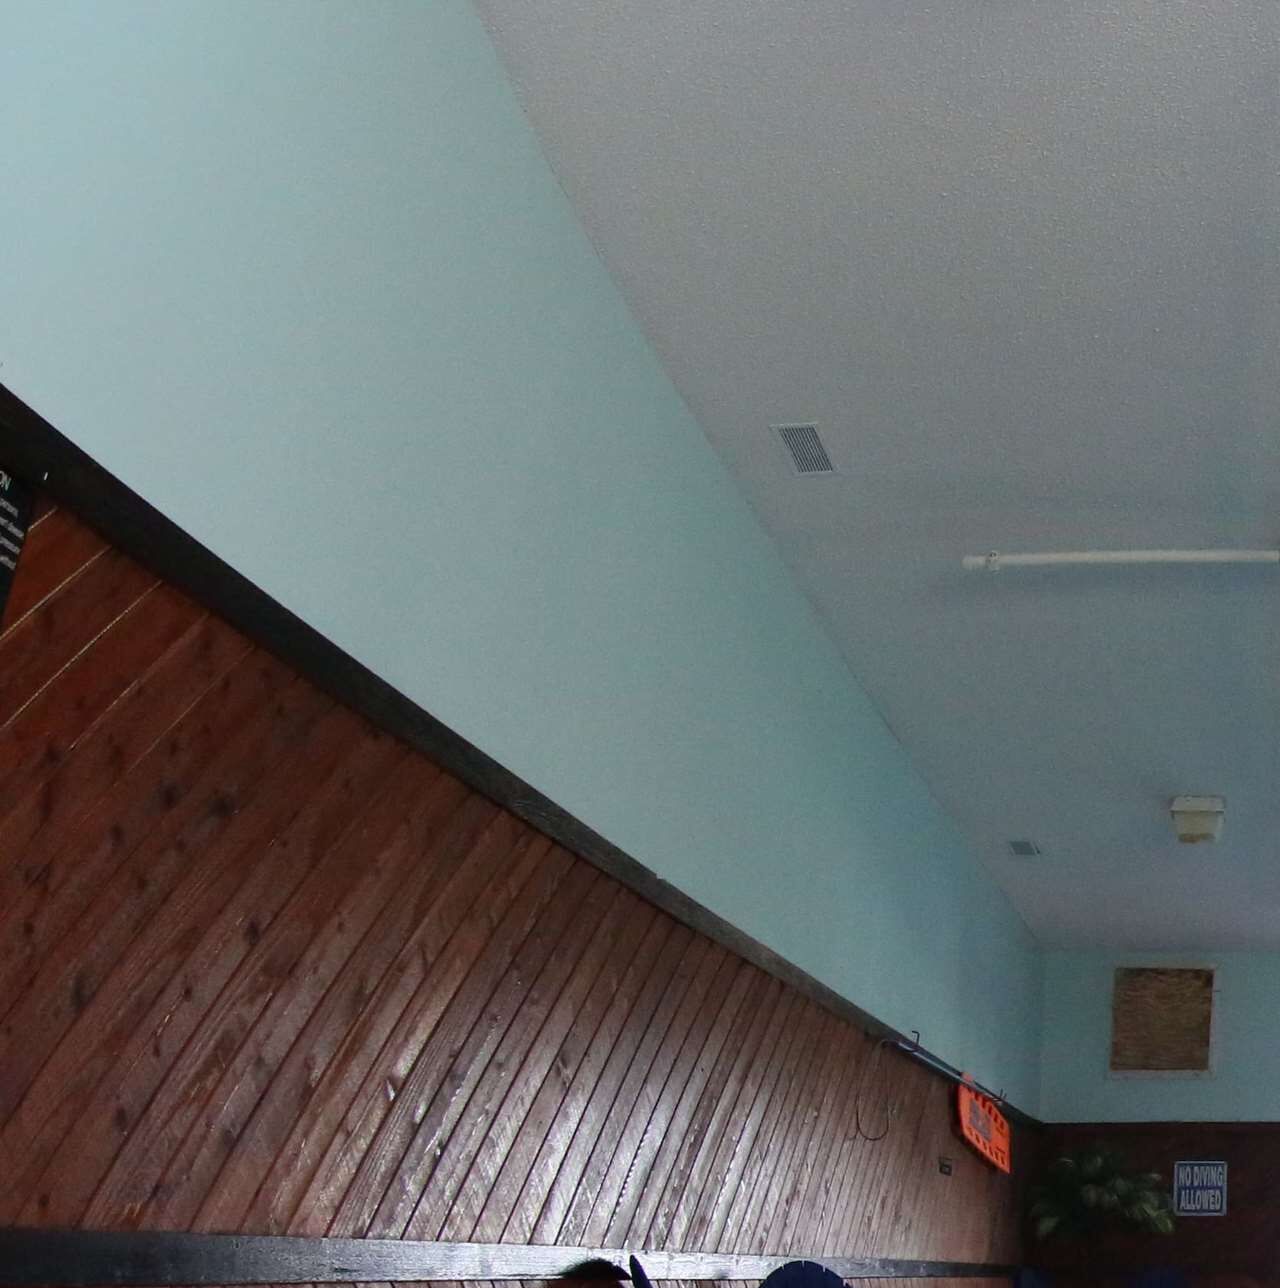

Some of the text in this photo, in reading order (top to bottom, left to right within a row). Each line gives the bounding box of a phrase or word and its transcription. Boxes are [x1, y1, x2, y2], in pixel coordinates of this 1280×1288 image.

[1179, 1166, 1224, 1186] NO DIVING
[1180, 1190, 1221, 1210] ALLOWED
